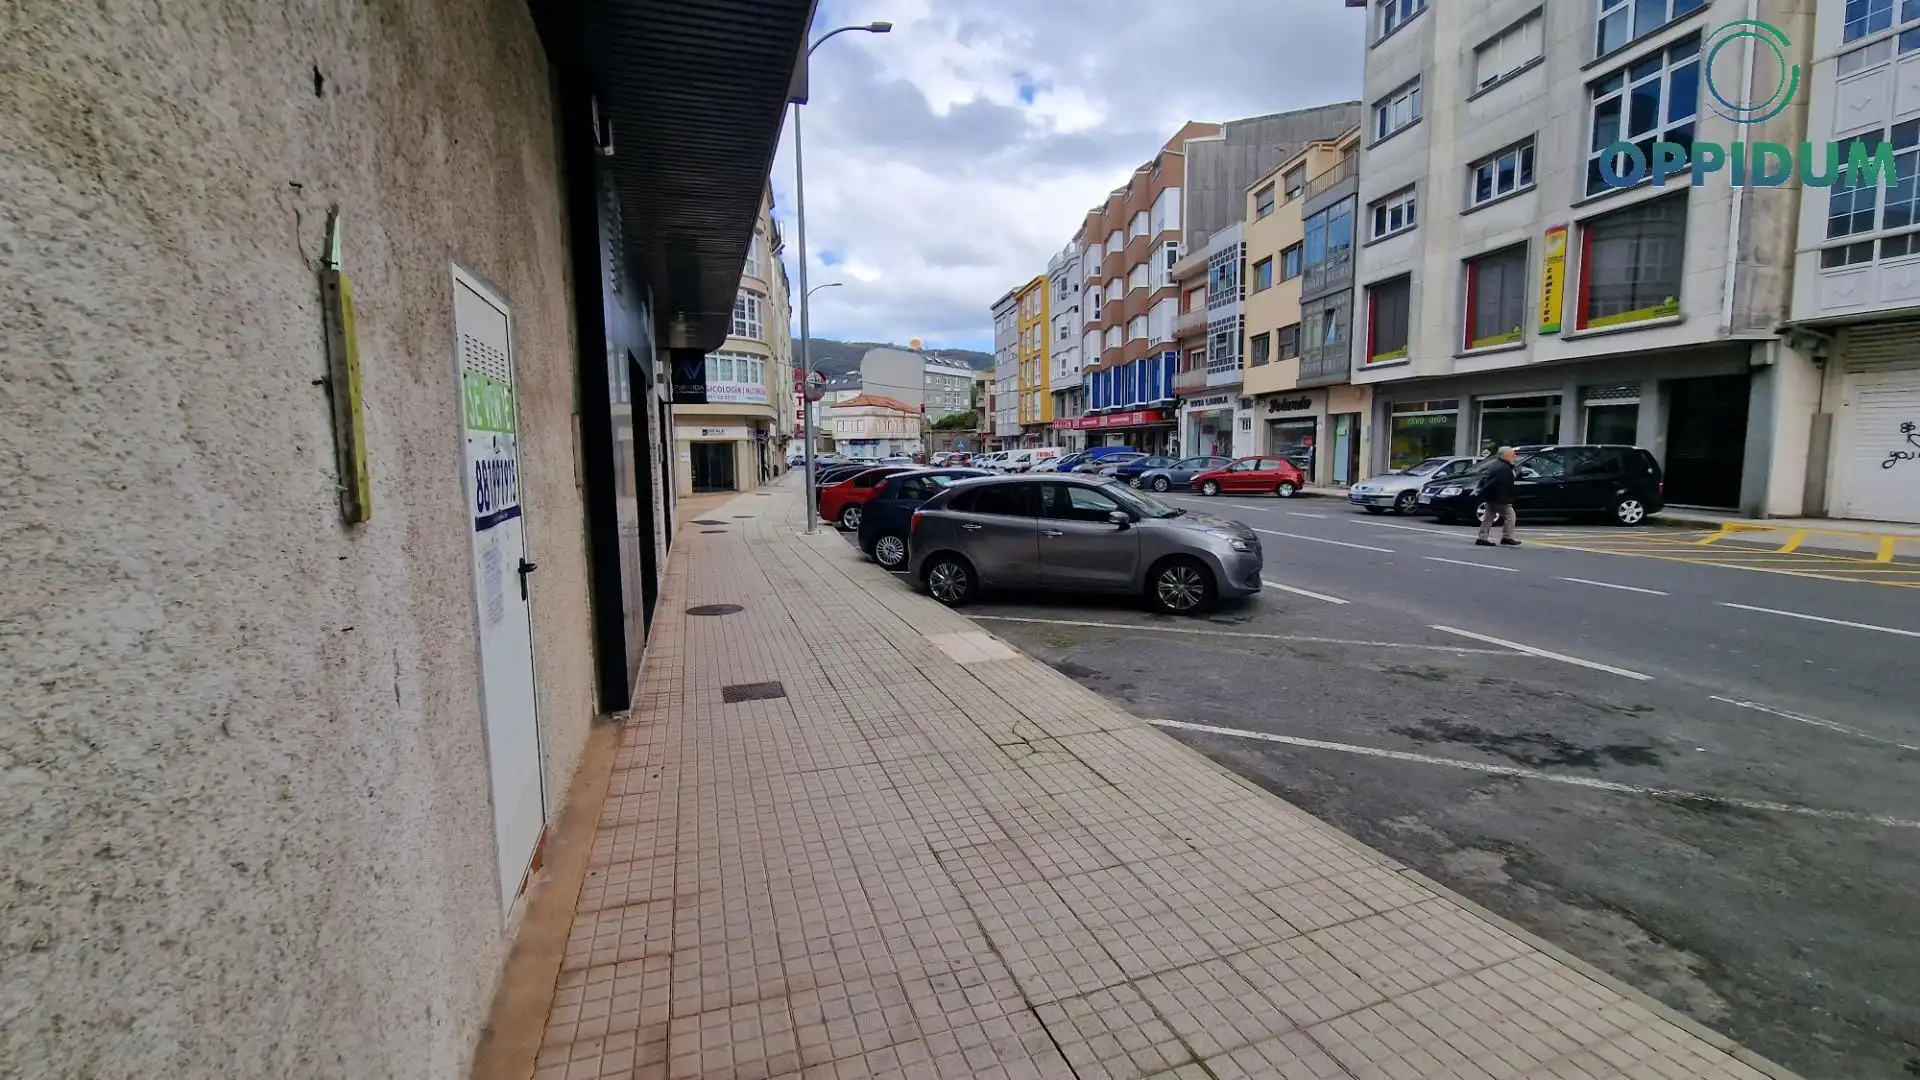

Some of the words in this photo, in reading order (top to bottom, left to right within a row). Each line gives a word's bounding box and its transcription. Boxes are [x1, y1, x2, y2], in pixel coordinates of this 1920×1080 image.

[1543, 267, 1553, 323] CAMBEIRO
[466, 376, 483, 427] SE
[706, 385, 741, 394] SICOLOGÍA
